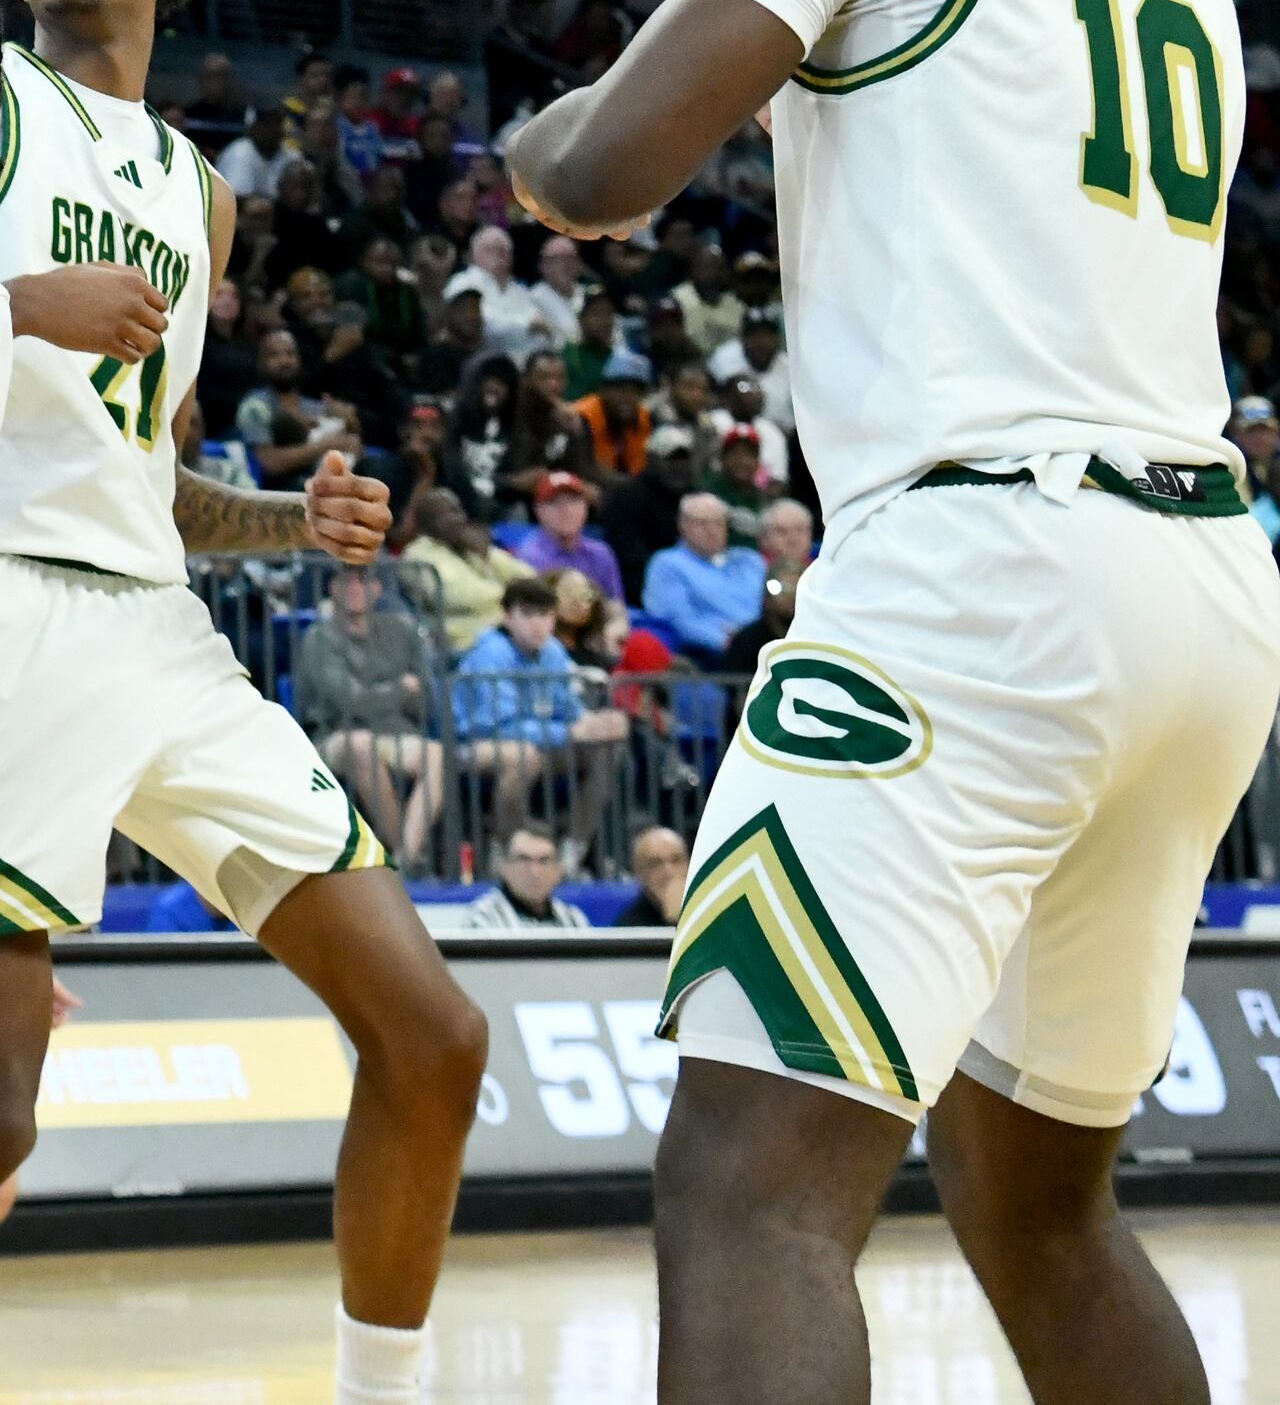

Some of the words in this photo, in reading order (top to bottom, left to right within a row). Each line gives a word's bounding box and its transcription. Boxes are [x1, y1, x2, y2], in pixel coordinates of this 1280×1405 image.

[746, 657, 913, 766] G
[41, 1044, 250, 1105] HEELER
[512, 1000, 681, 1139] 55
